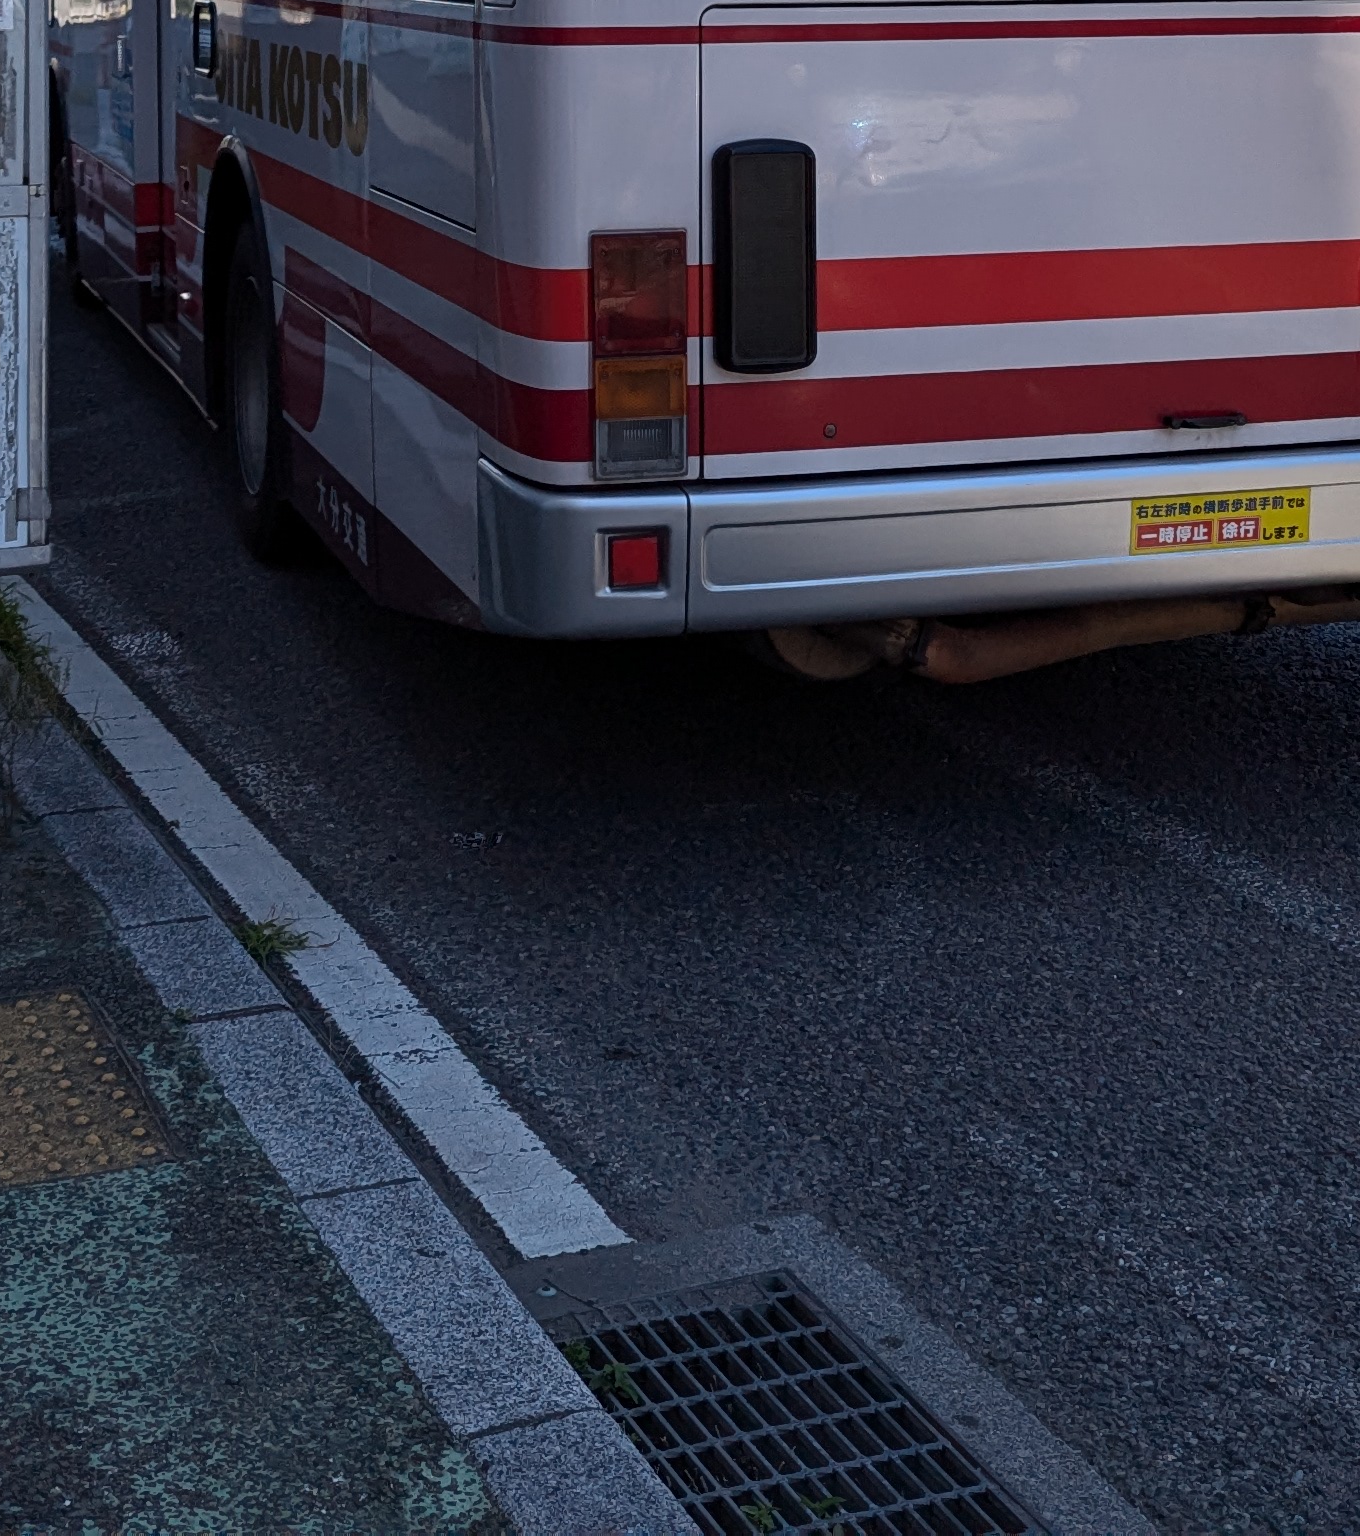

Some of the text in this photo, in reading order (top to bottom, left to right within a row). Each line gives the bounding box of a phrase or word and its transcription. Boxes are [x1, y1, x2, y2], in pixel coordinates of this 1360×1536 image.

[268, 43, 368, 157] KOTSU
[1135, 495, 1306, 520] 右左折時の横断歩道手前では
[1140, 519, 1304, 543] 一時停止 徐行 します。
